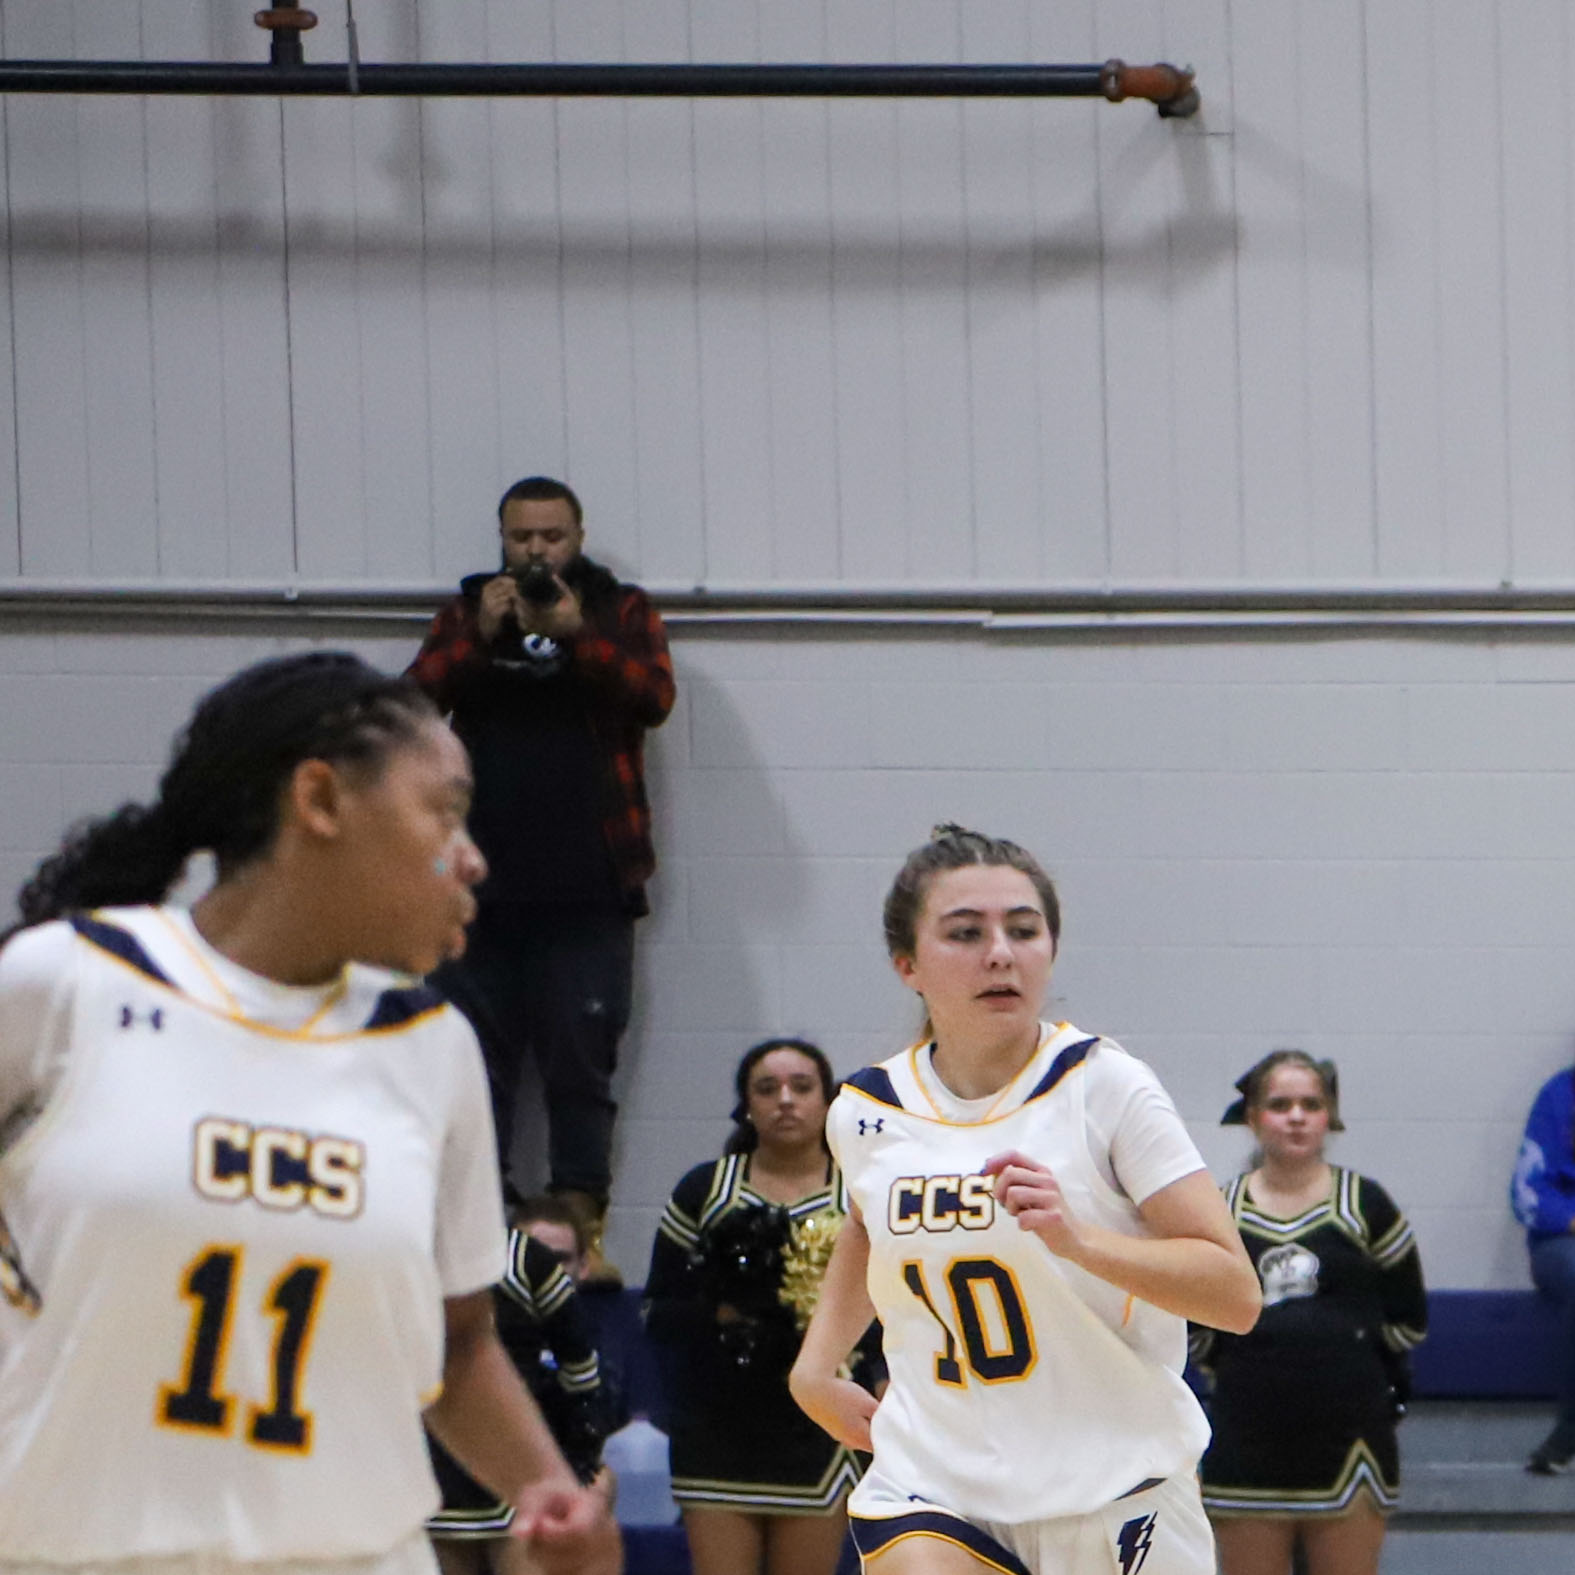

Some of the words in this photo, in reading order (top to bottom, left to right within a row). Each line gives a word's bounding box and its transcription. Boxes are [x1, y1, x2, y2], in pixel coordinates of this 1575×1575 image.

[193, 1116, 366, 1221] CCS
[888, 1173, 996, 1235] CCS
[155, 1243, 332, 1457] 11
[901, 1255, 1039, 1390] 10
